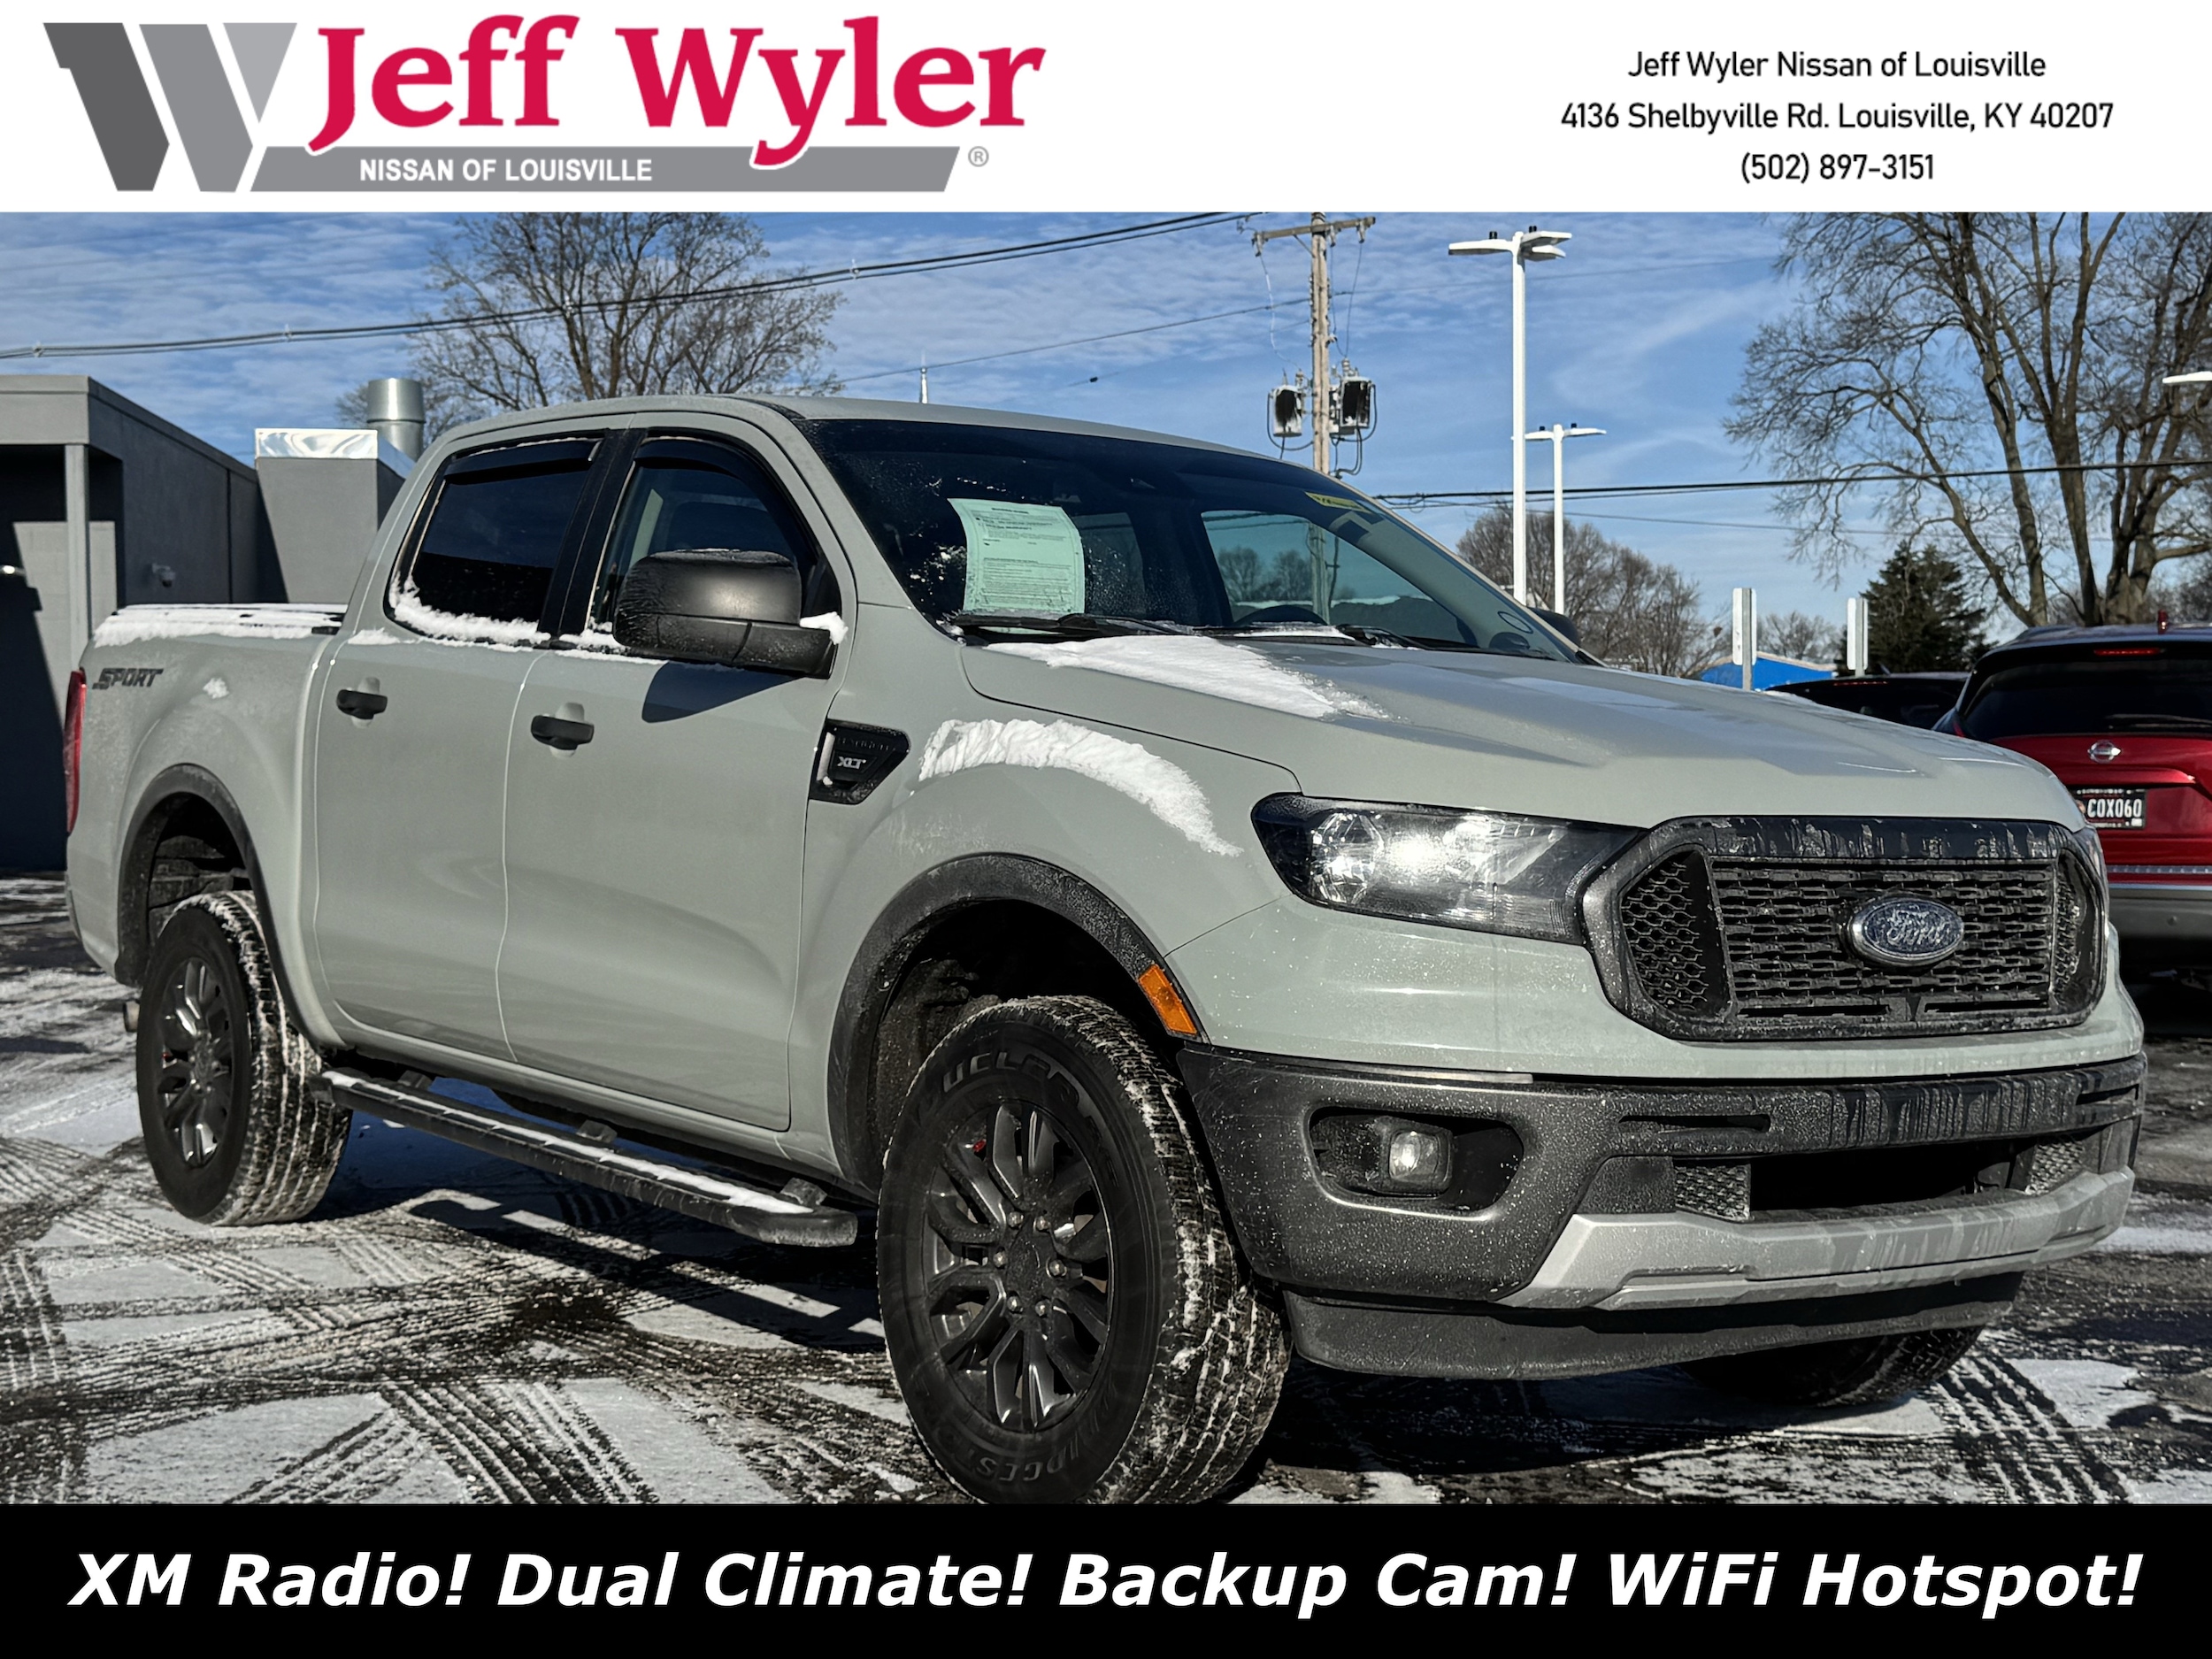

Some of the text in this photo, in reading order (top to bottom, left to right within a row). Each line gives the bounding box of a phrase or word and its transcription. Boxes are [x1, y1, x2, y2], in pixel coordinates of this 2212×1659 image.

[92, 667, 165, 690] SPORT
[837, 756, 867, 770] XLT
[1886, 908, 1952, 947] Ford
